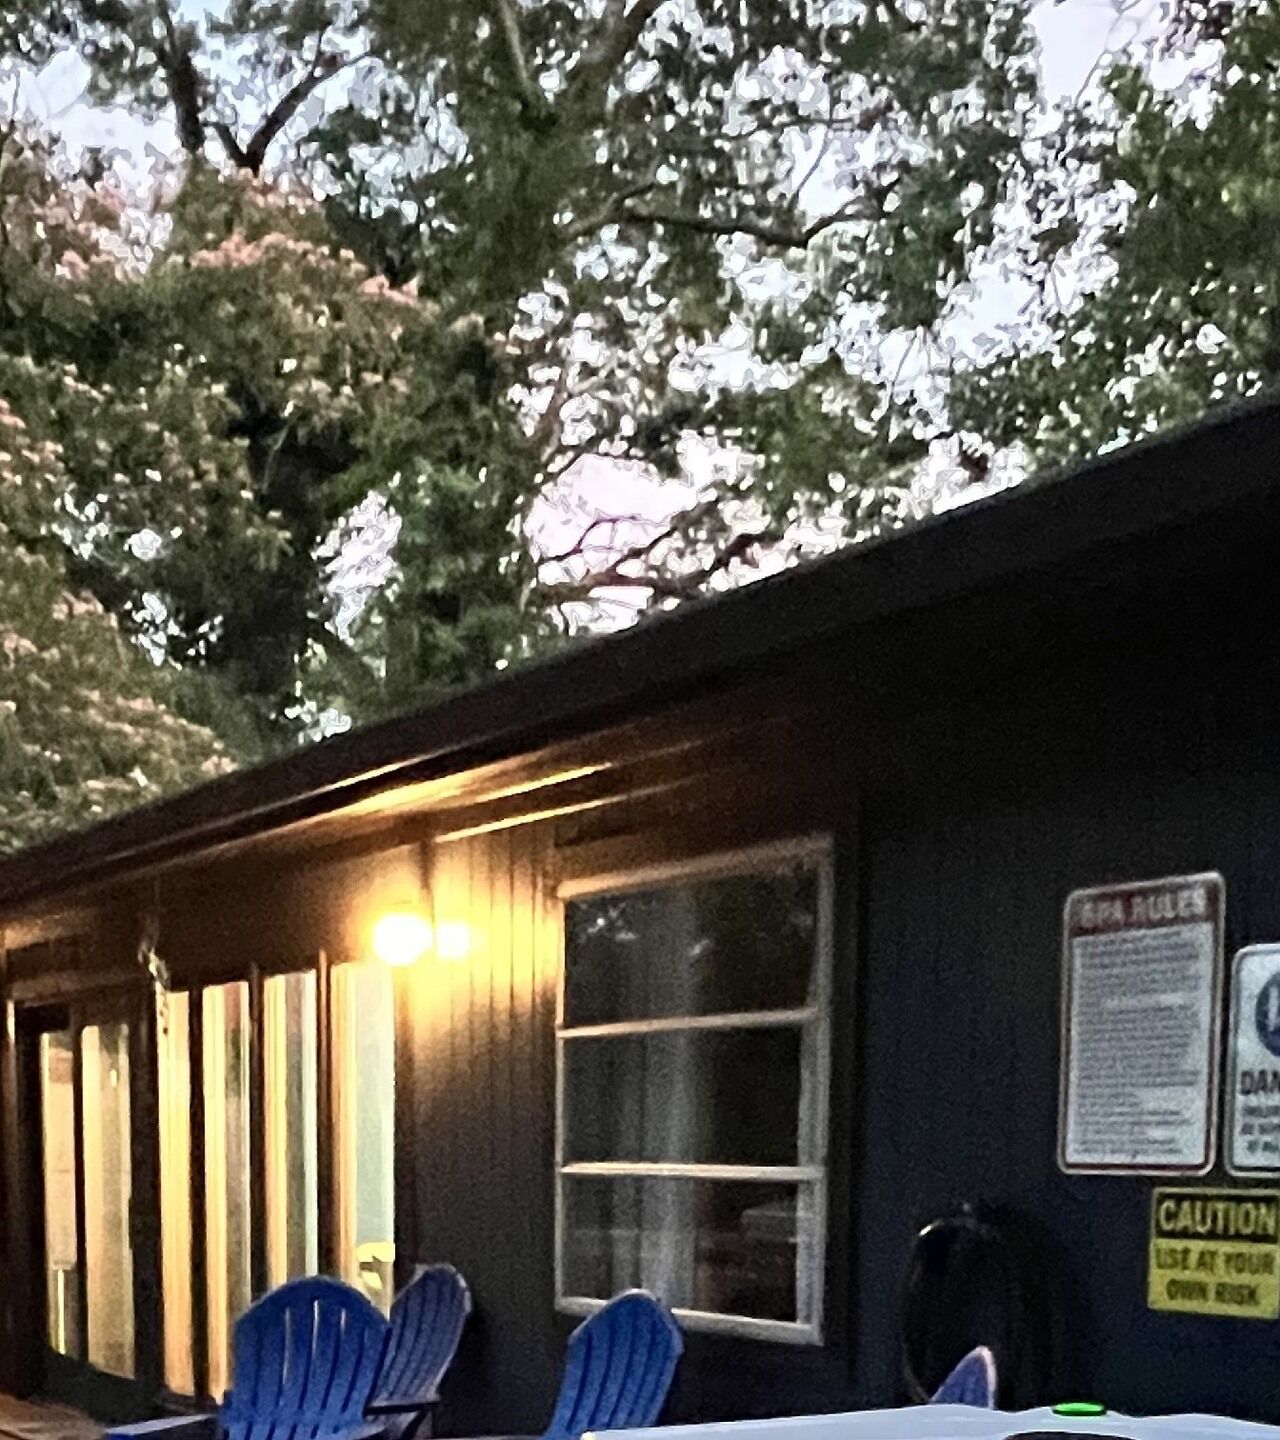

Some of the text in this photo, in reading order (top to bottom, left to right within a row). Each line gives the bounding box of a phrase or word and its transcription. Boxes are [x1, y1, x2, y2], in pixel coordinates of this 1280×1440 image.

[1160, 1199, 1276, 1236] CAUTION
[1155, 1246, 1275, 1276] USE AT YOUR
[1166, 1278, 1208, 1302] OWN
